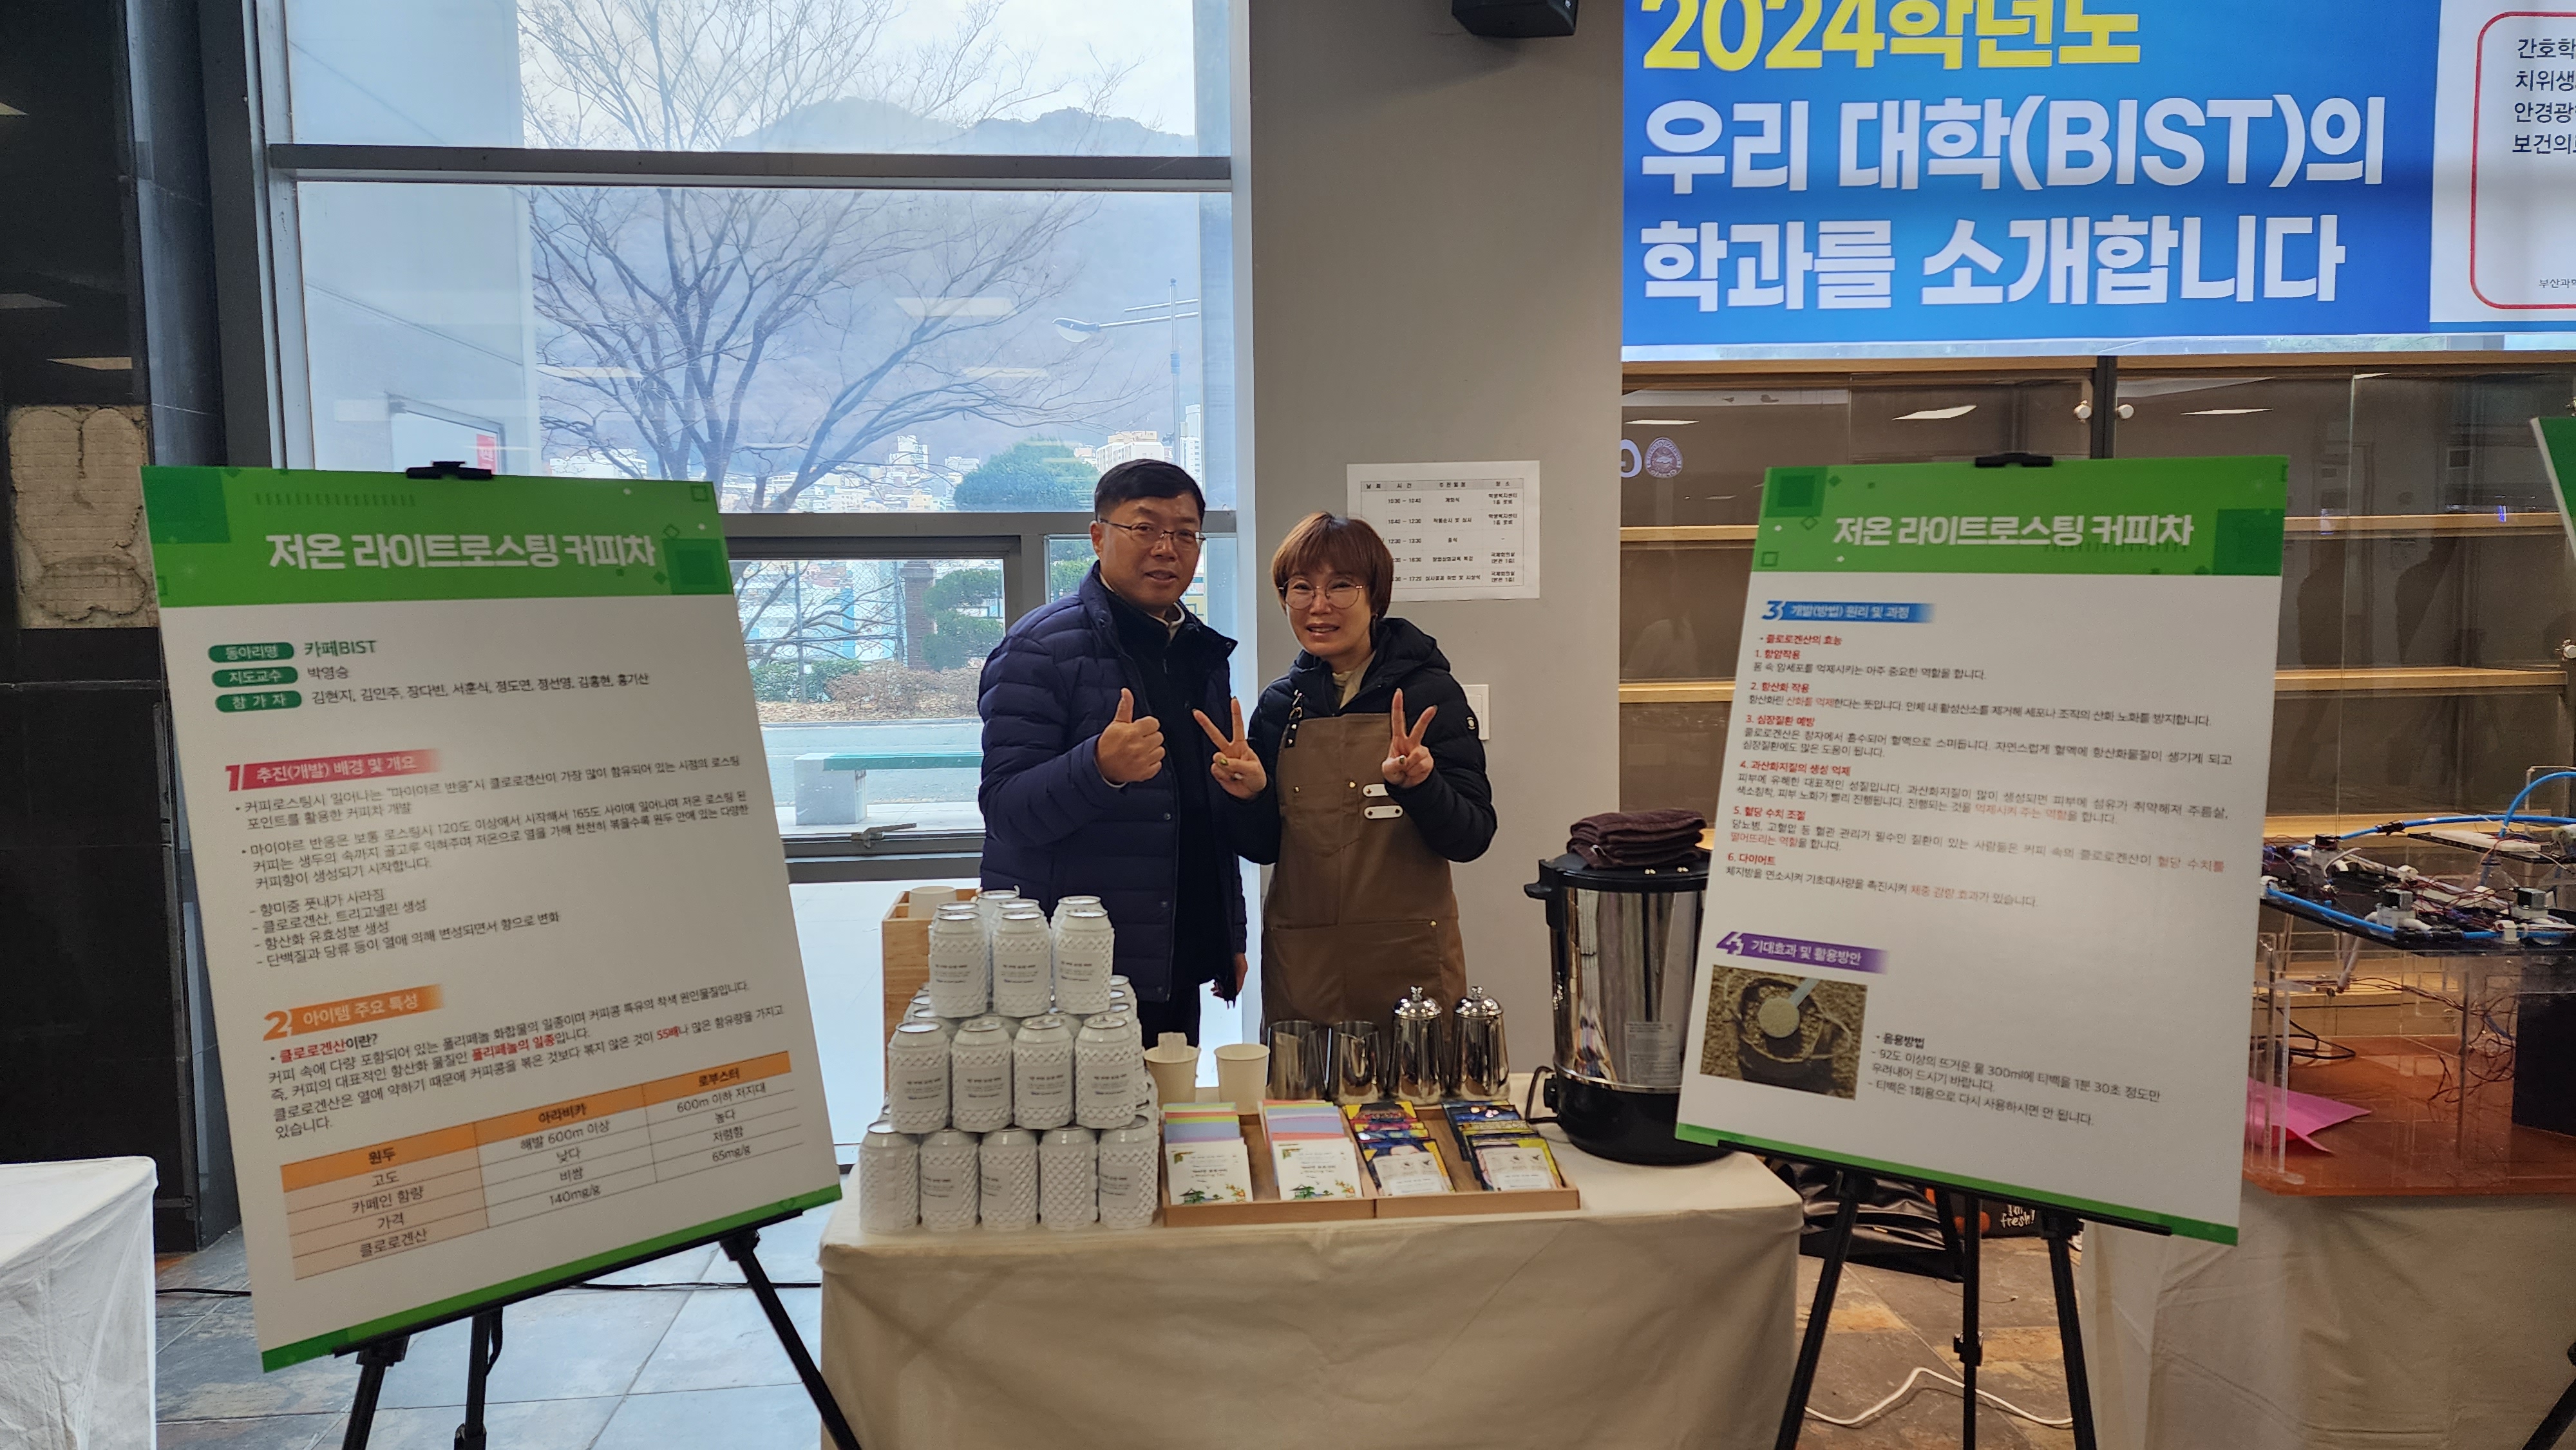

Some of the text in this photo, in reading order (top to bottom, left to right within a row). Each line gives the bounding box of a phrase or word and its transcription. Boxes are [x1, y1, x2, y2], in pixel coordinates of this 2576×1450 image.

[2515, 70, 2576, 92] 치위생
[2514, 102, 2576, 124] 안경광
[1641, 93, 2387, 194] 우리 대학(BIST)의
[1640, 214, 2347, 312] 학과를 소개합니다
[1833, 514, 2193, 546] 저온 라이트로스팅 커피차
[266, 533, 655, 570] 저온 라이트로스팅 커피차
[304, 639, 376, 657] 카페BIST
[346, 804, 383, 819] 커피차
[676, 1097, 710, 1113] 600m
[547, 1127, 584, 1144] 600m
[2000, 1209, 2036, 1229] fresh!
